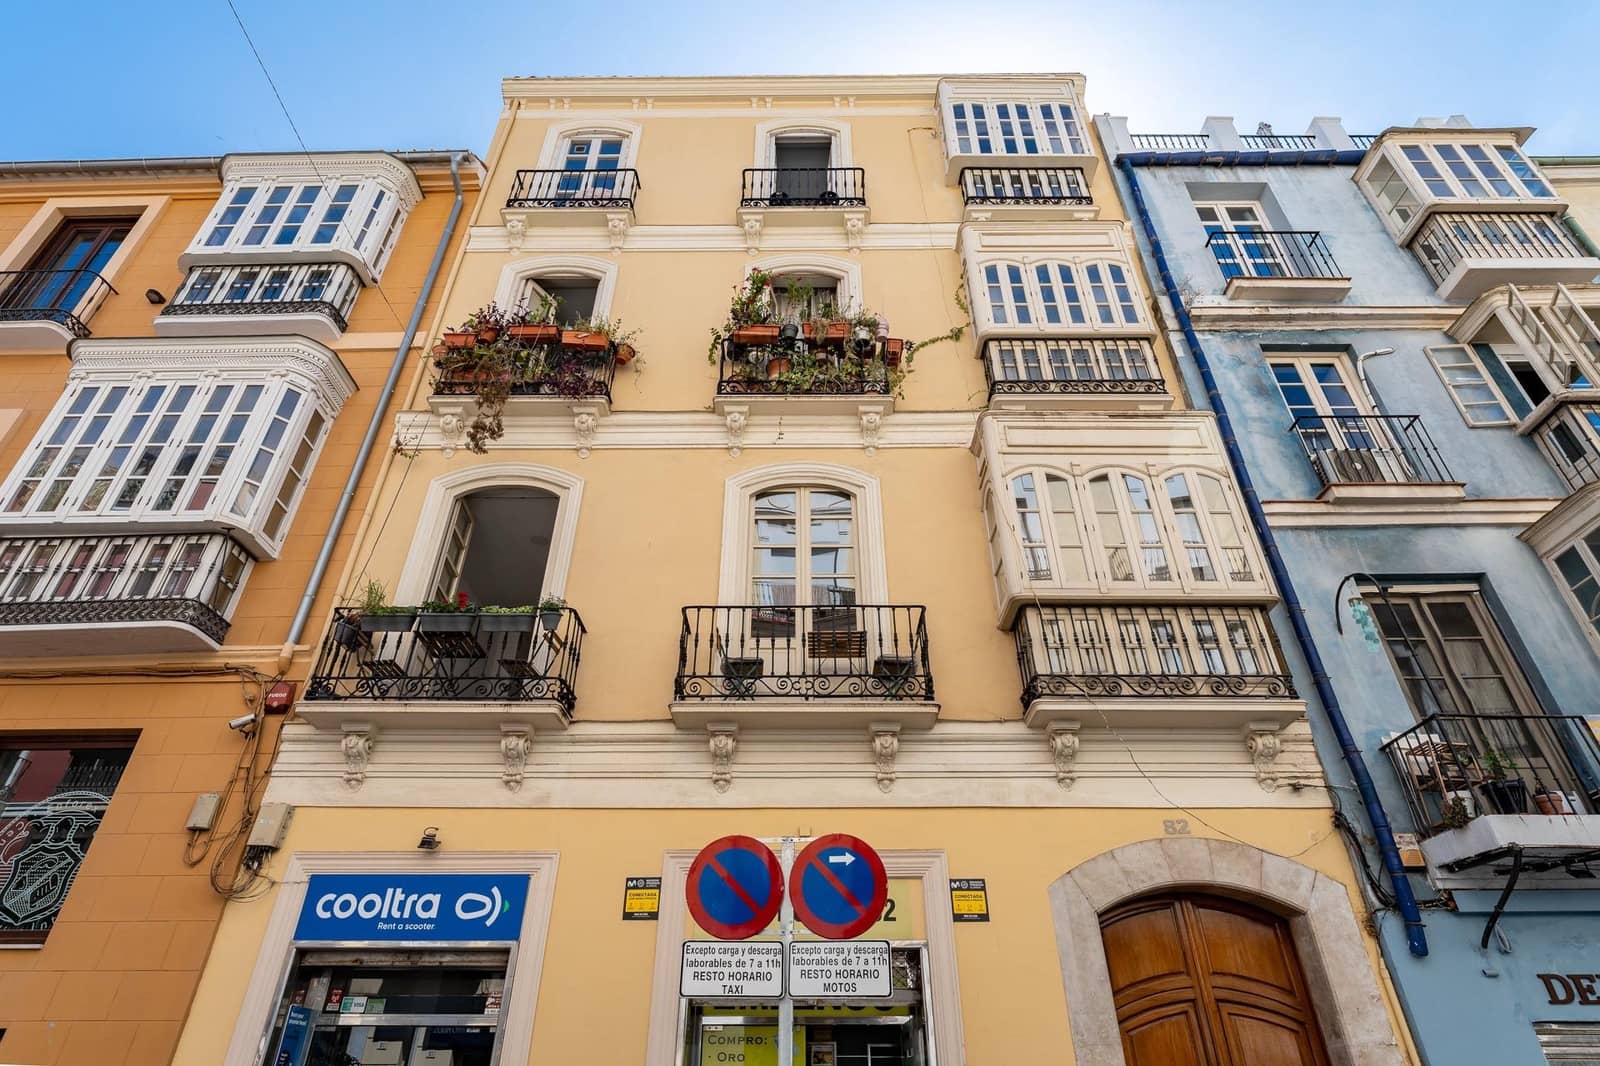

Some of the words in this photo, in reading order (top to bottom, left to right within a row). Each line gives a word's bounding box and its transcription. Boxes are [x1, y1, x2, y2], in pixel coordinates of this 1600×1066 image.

[1163, 819, 1192, 835] 82
[316, 888, 441, 919] cooltra
[377, 922, 396, 931] Rent
[405, 923, 436, 931] scooter
[685, 945, 716, 957] Excepto
[718, 947, 738, 957] carga
[741, 947, 746, 957] y
[748, 946, 782, 957] descarga
[791, 945, 822, 956] Excepto
[823, 947, 845, 956] carga
[847, 947, 851, 956] y
[853, 945, 888, 956] descarga
[686, 958, 732, 968] laborables
[735, 959, 746, 968] de
[749, 959, 754, 968] 7
[766, 959, 781, 968] 11h
[792, 956, 839, 966] laborables
[841, 956, 852, 966] de
[855, 956, 861, 966] 7
[872, 957, 888, 966] 11h
[693, 971, 725, 981] RESTO
[728, 971, 773, 981] HORARIO
[800, 969, 832, 979] RESTO
[835, 969, 880, 979] HORARIO
[722, 984, 744, 994] TAXI
[823, 982, 857, 992] MOTOS
[1536, 973, 1600, 1005] DE
